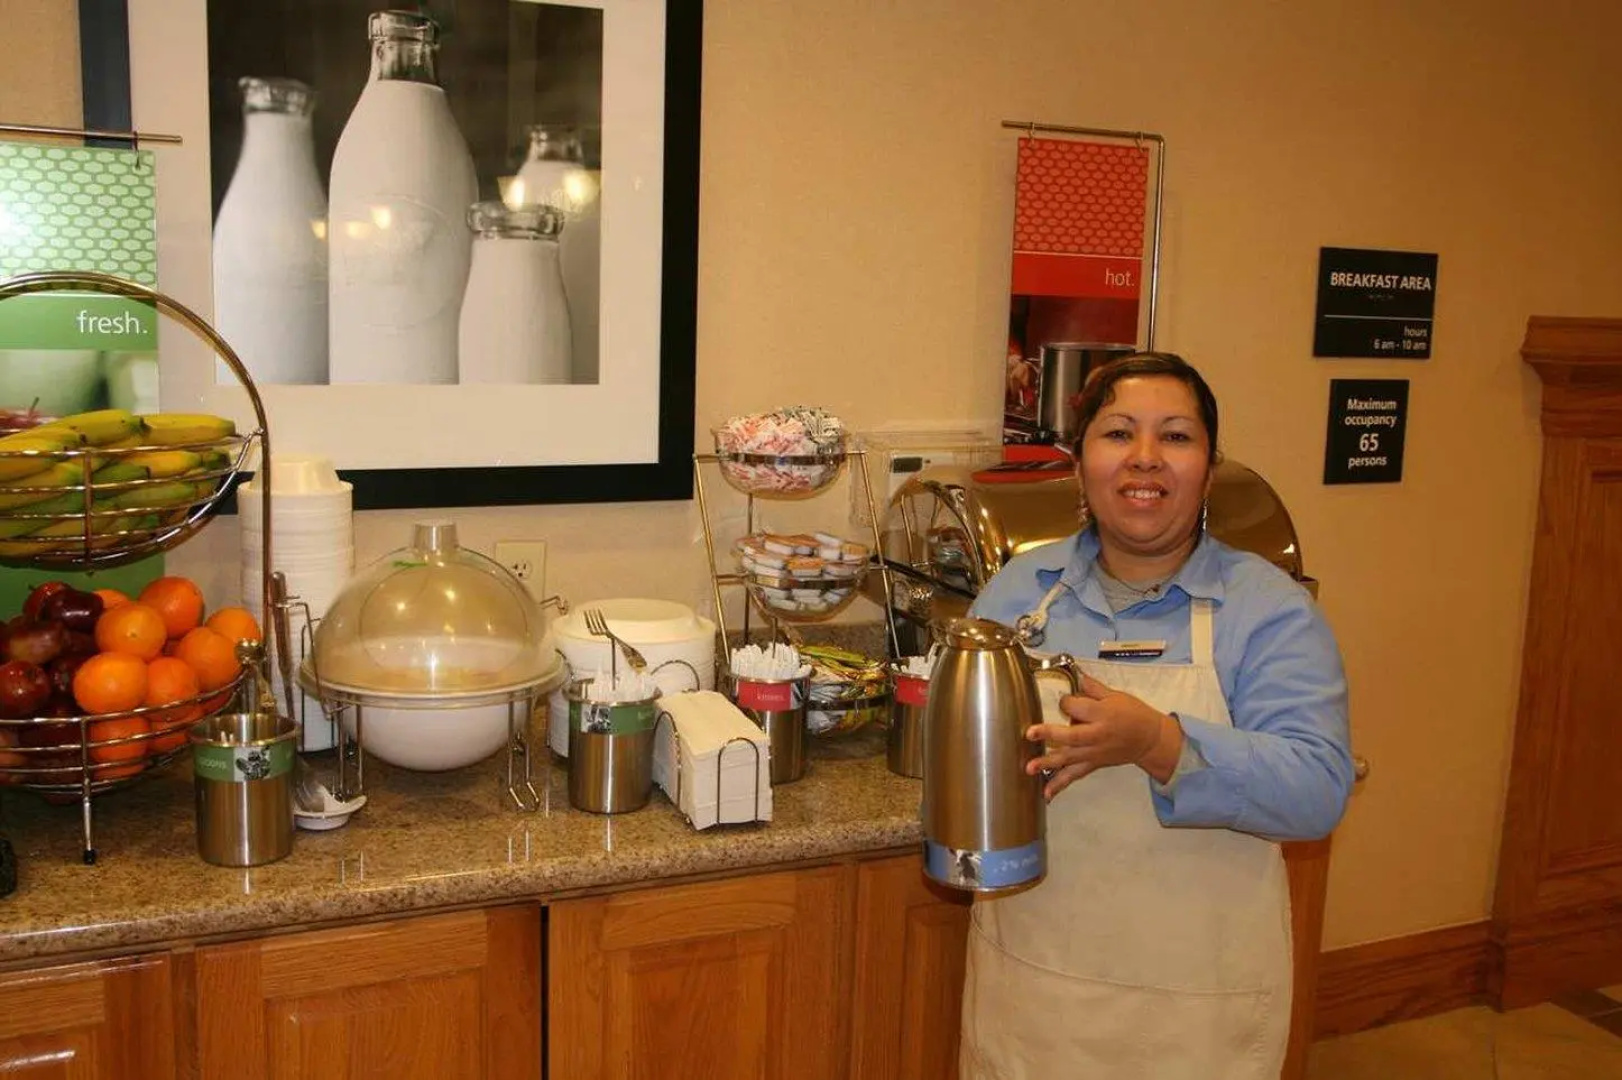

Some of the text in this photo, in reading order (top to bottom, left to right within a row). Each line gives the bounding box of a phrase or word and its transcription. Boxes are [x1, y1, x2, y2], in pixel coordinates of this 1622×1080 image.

[1105, 267, 1135, 286] hot.
[1330, 271, 1431, 291] BREAKFAST AREA
[76, 309, 148, 334] fresh.
[1404, 325, 1428, 337] hours
[1373, 338, 1380, 350] 6
[1381, 341, 1395, 351] am
[1402, 339, 1412, 351] 10
[1412, 341, 1427, 351] am
[1347, 397, 1397, 411] Maximum
[1344, 415, 1398, 429] occupancy
[1359, 432, 1379, 452] 65
[1347, 456, 1388, 470] persons
